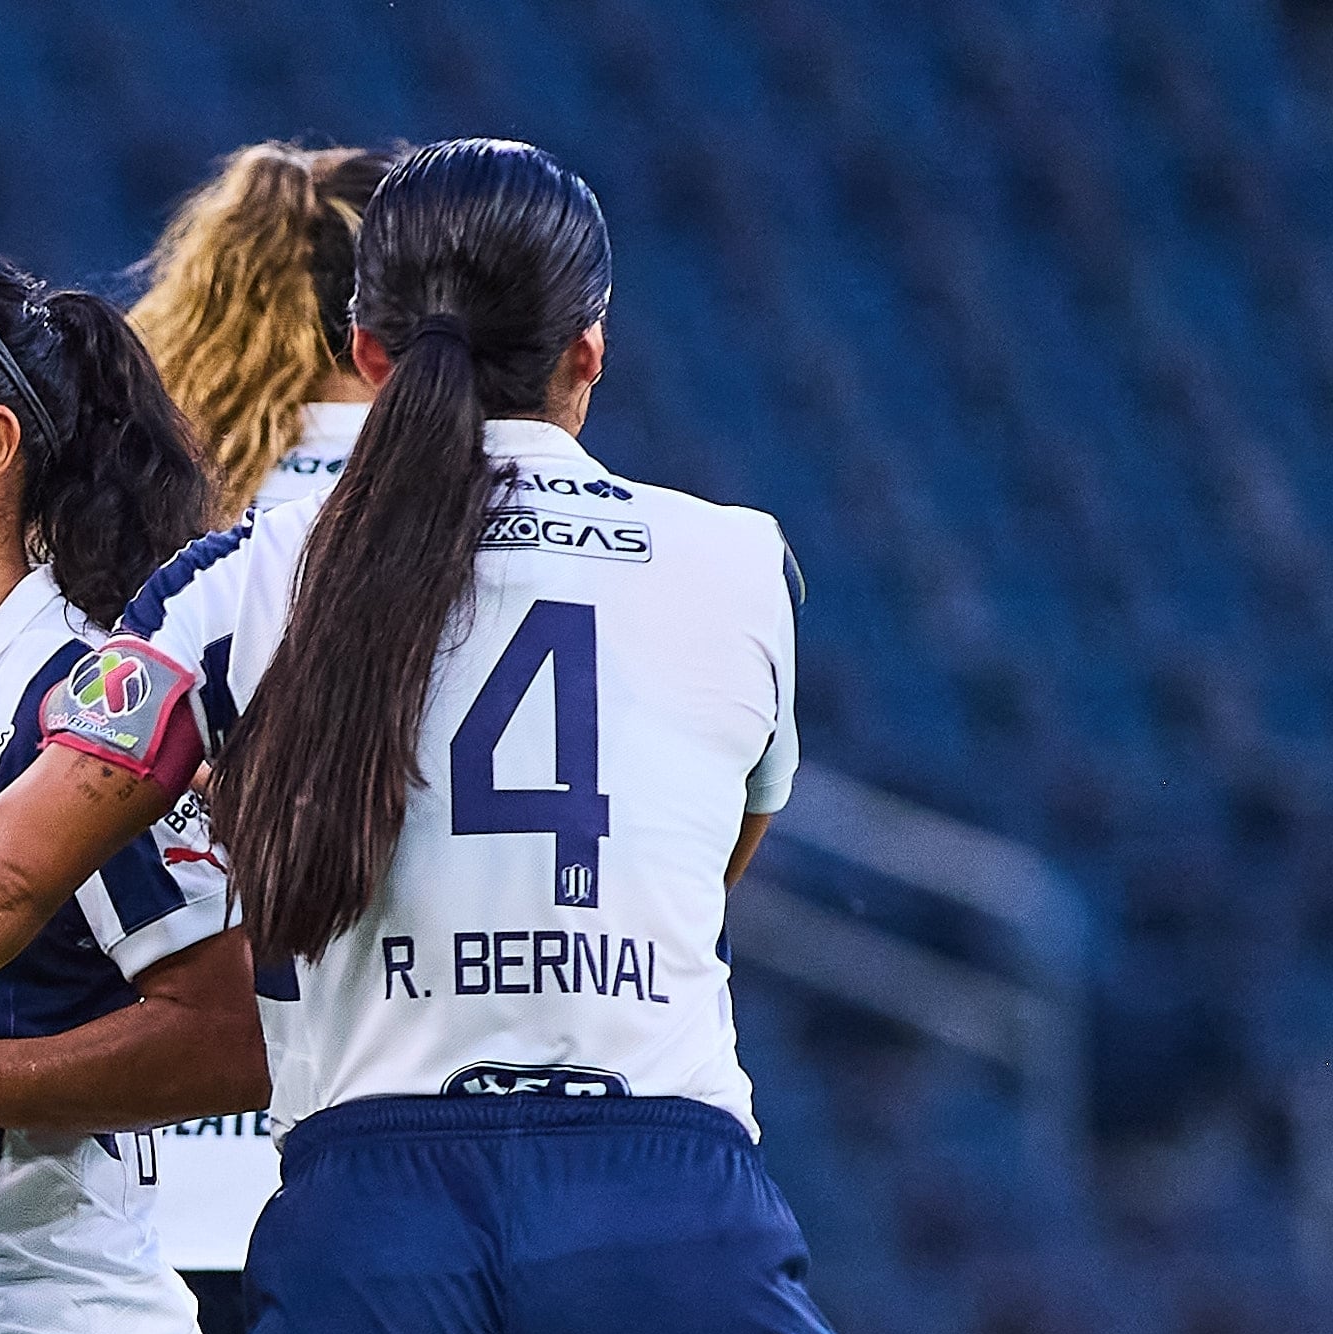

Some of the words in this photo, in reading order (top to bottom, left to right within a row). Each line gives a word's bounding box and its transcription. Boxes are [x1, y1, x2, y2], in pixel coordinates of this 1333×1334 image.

[450, 599, 610, 908] 4
[382, 935, 432, 1000] R.
[454, 930, 671, 1004] BERNAL
